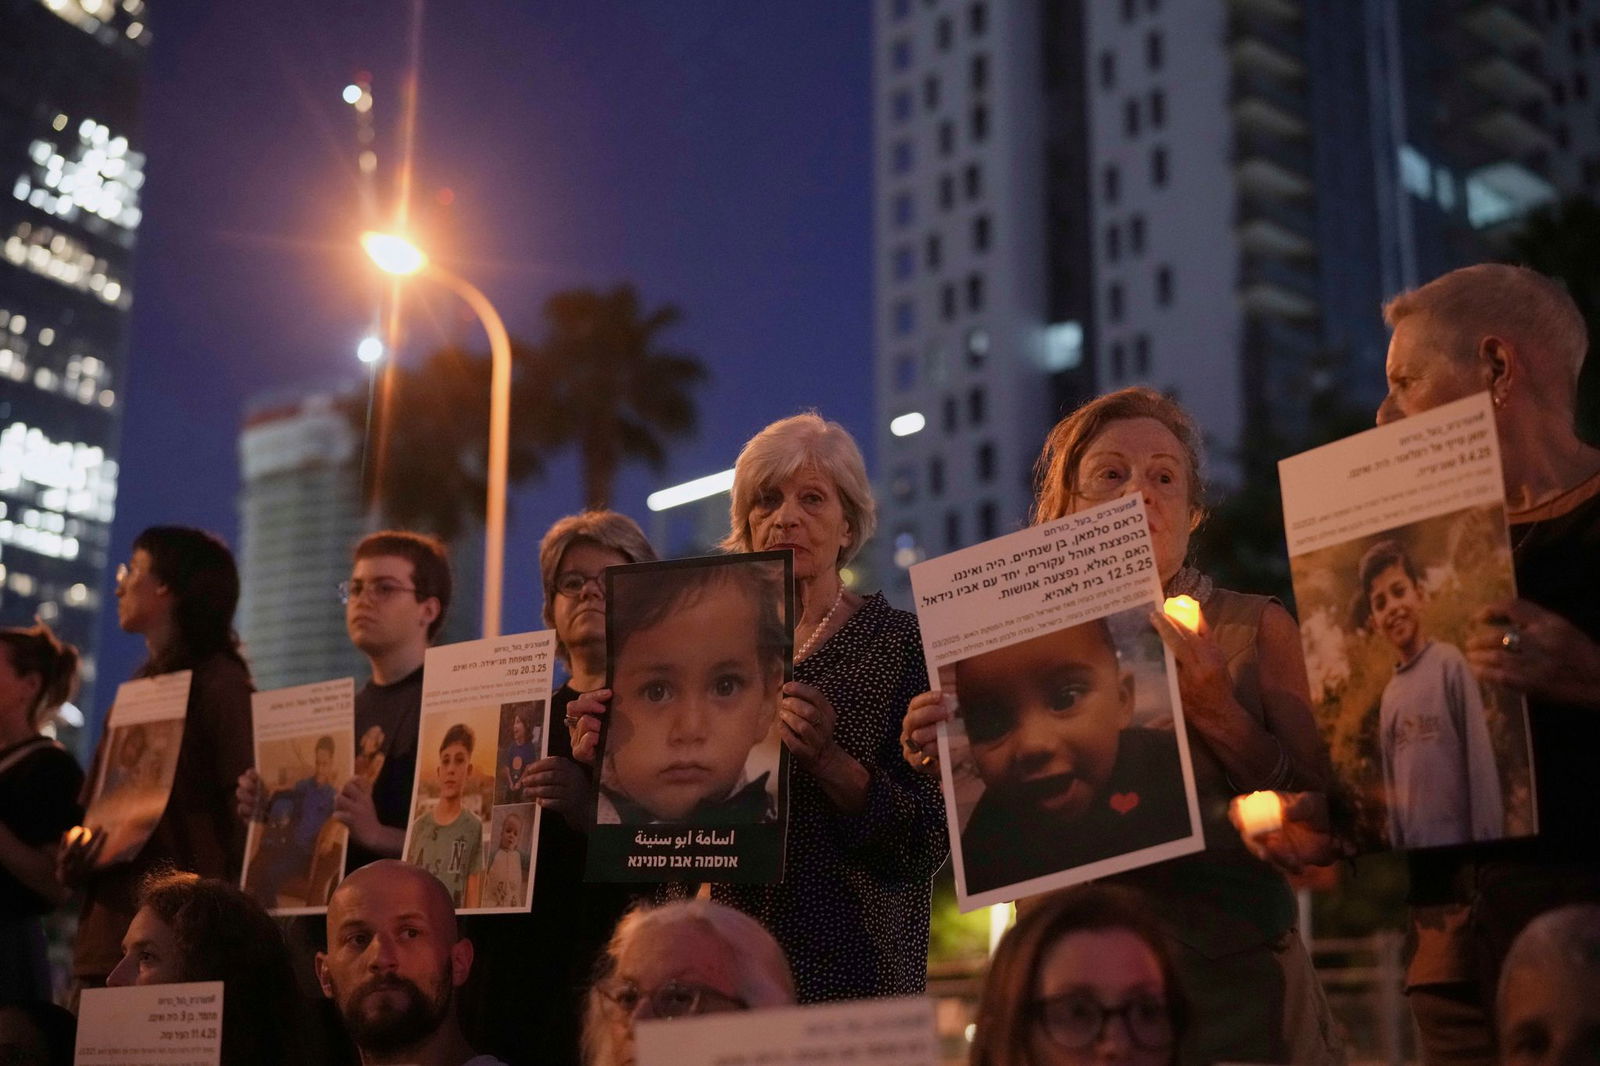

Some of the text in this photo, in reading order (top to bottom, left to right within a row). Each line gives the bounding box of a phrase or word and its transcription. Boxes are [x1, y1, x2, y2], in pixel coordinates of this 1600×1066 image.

[1113, 513, 1144, 530] כראם
[1056, 539, 1068, 551] בן
[1010, 543, 1052, 565] שנתיים.
[921, 529, 1147, 608] בהפצצת אוהל עקורים, יחד עם אביו נידאל.
[986, 558, 1006, 571] היה
[998, 544, 1150, 600] האם, האלא, נפצעה אנושות.
[951, 566, 982, 582] ואיננו.
[1041, 557, 1153, 602] 12.5.25 בית לאהיא.
[520, 664, 547, 675] 20.3.25
[635, 830, 735, 849] اسامة ابو سنينة
[628, 856, 739, 868] אוסמה אבו סונינא
